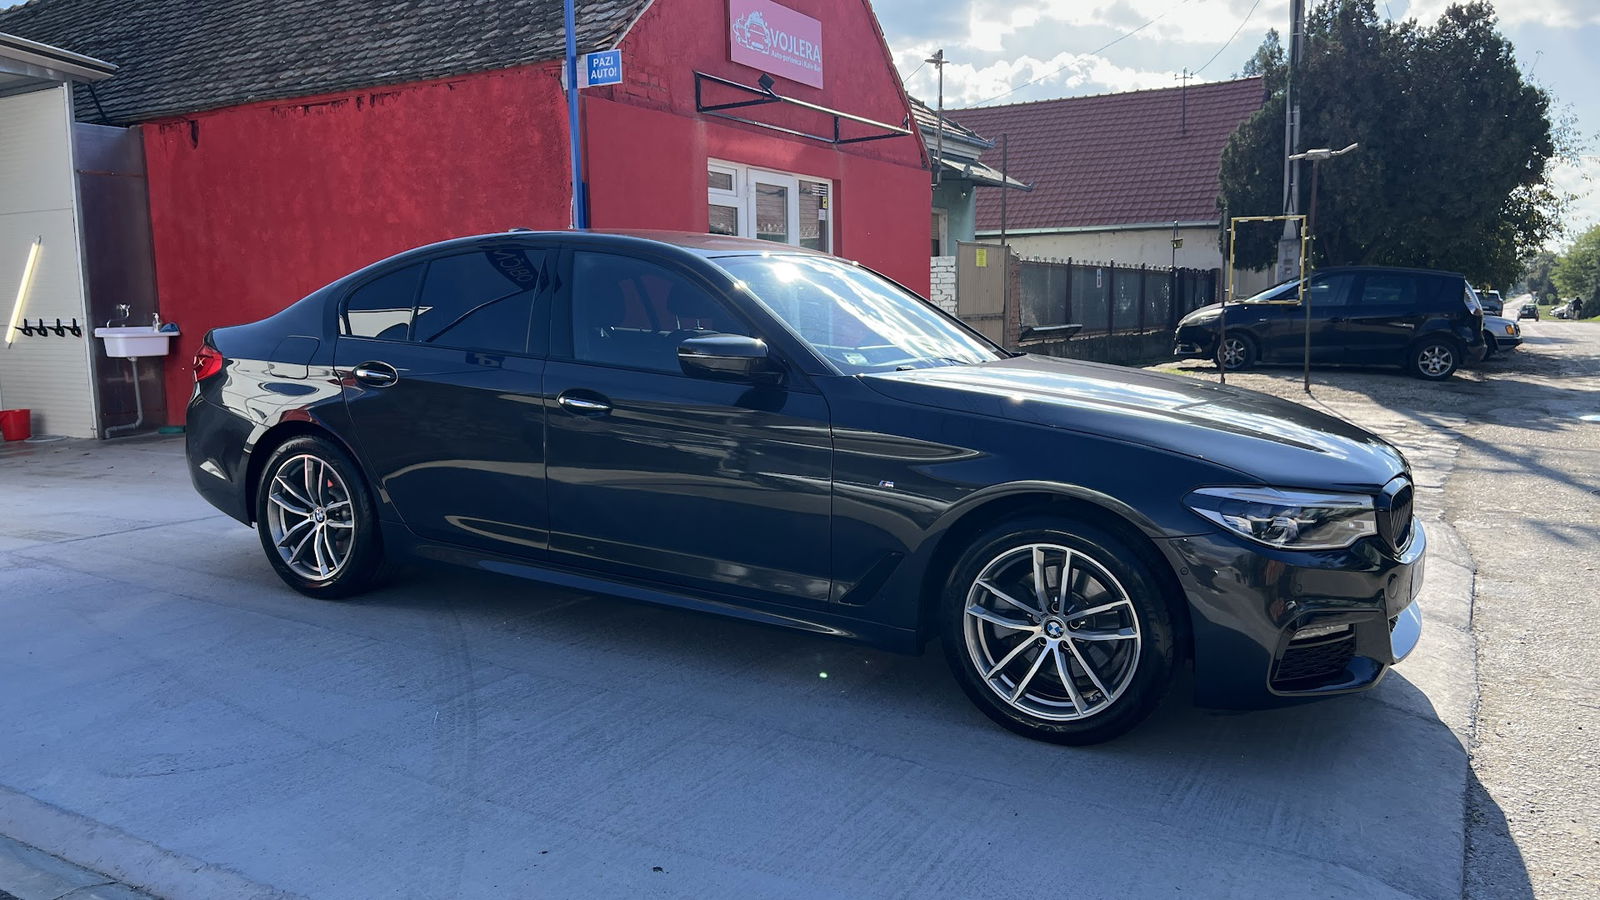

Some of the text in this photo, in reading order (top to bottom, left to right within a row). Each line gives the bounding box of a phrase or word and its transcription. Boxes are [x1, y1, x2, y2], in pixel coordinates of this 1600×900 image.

[770, 28, 821, 63] VOJLERA
[593, 56, 614, 68] PAZI
[590, 67, 617, 80] AUTO!
